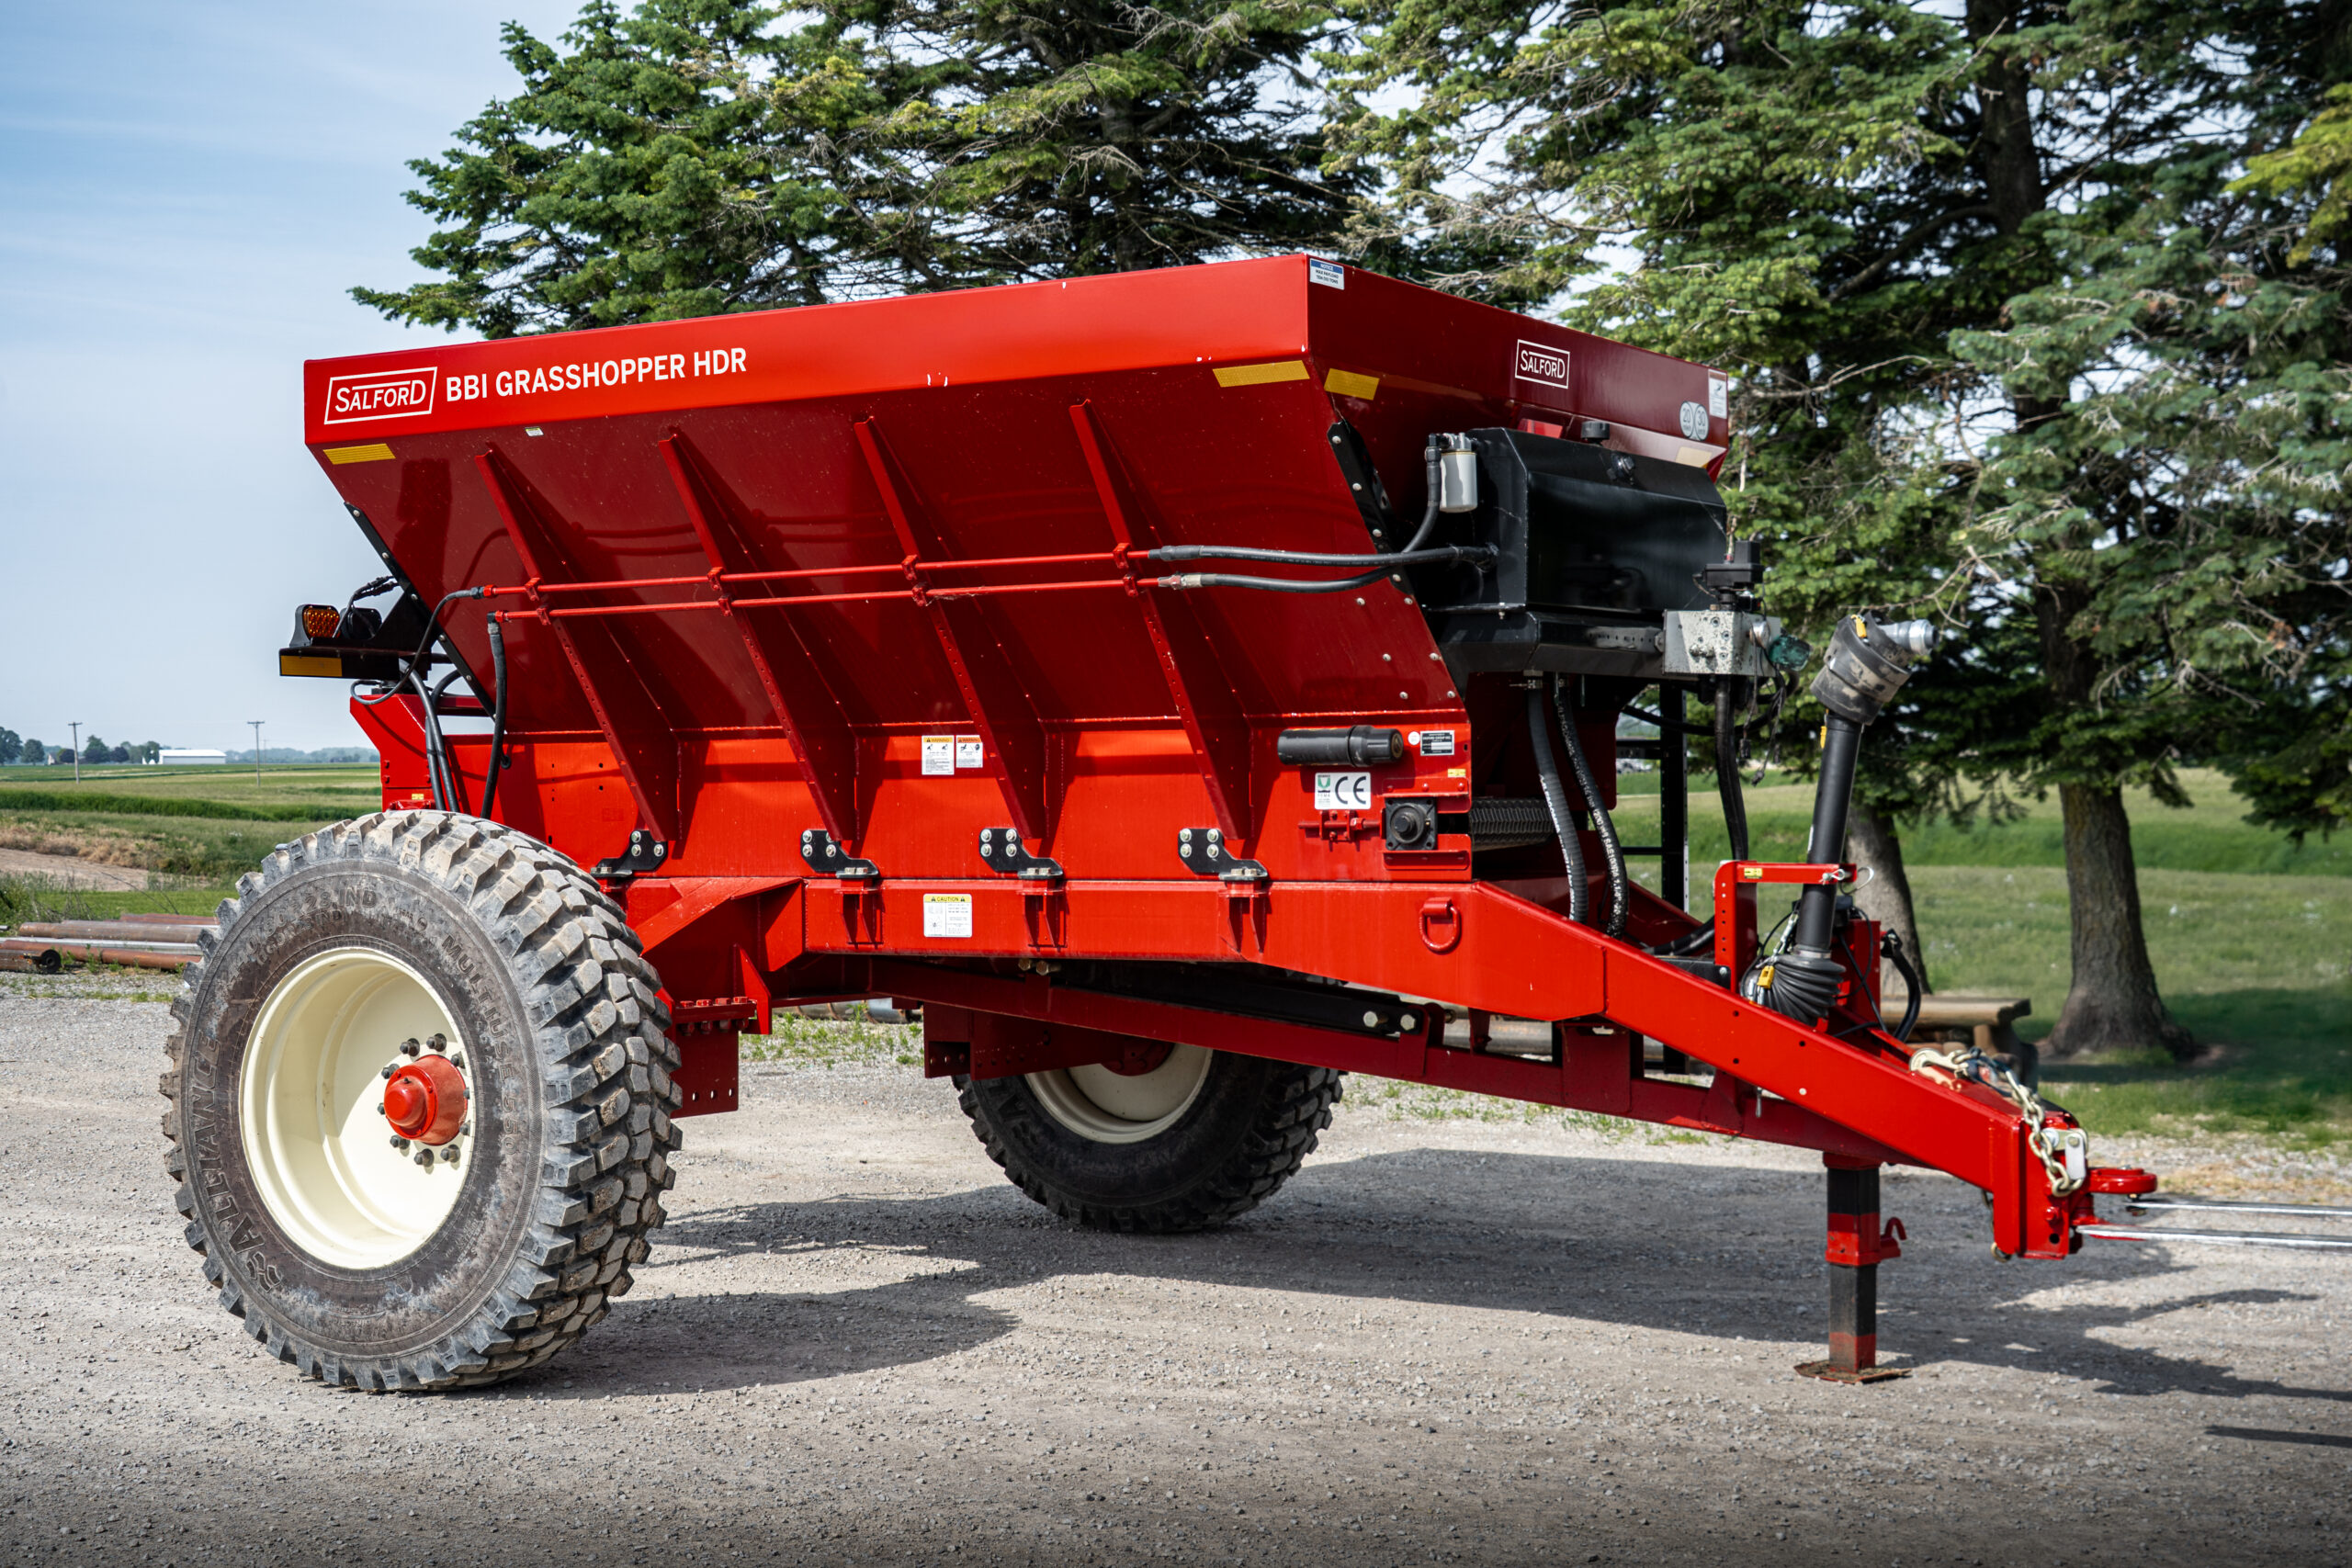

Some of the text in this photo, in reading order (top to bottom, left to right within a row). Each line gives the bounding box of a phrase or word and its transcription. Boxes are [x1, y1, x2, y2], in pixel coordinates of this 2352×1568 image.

[334, 347, 747, 413] SALFORD BBI GRASSHOPPER HDR
[1520, 349, 1566, 379] SALFORD
[442, 934, 519, 1156] MULTIUSE 550
[192, 1026, 266, 1256] ALLIANCE
